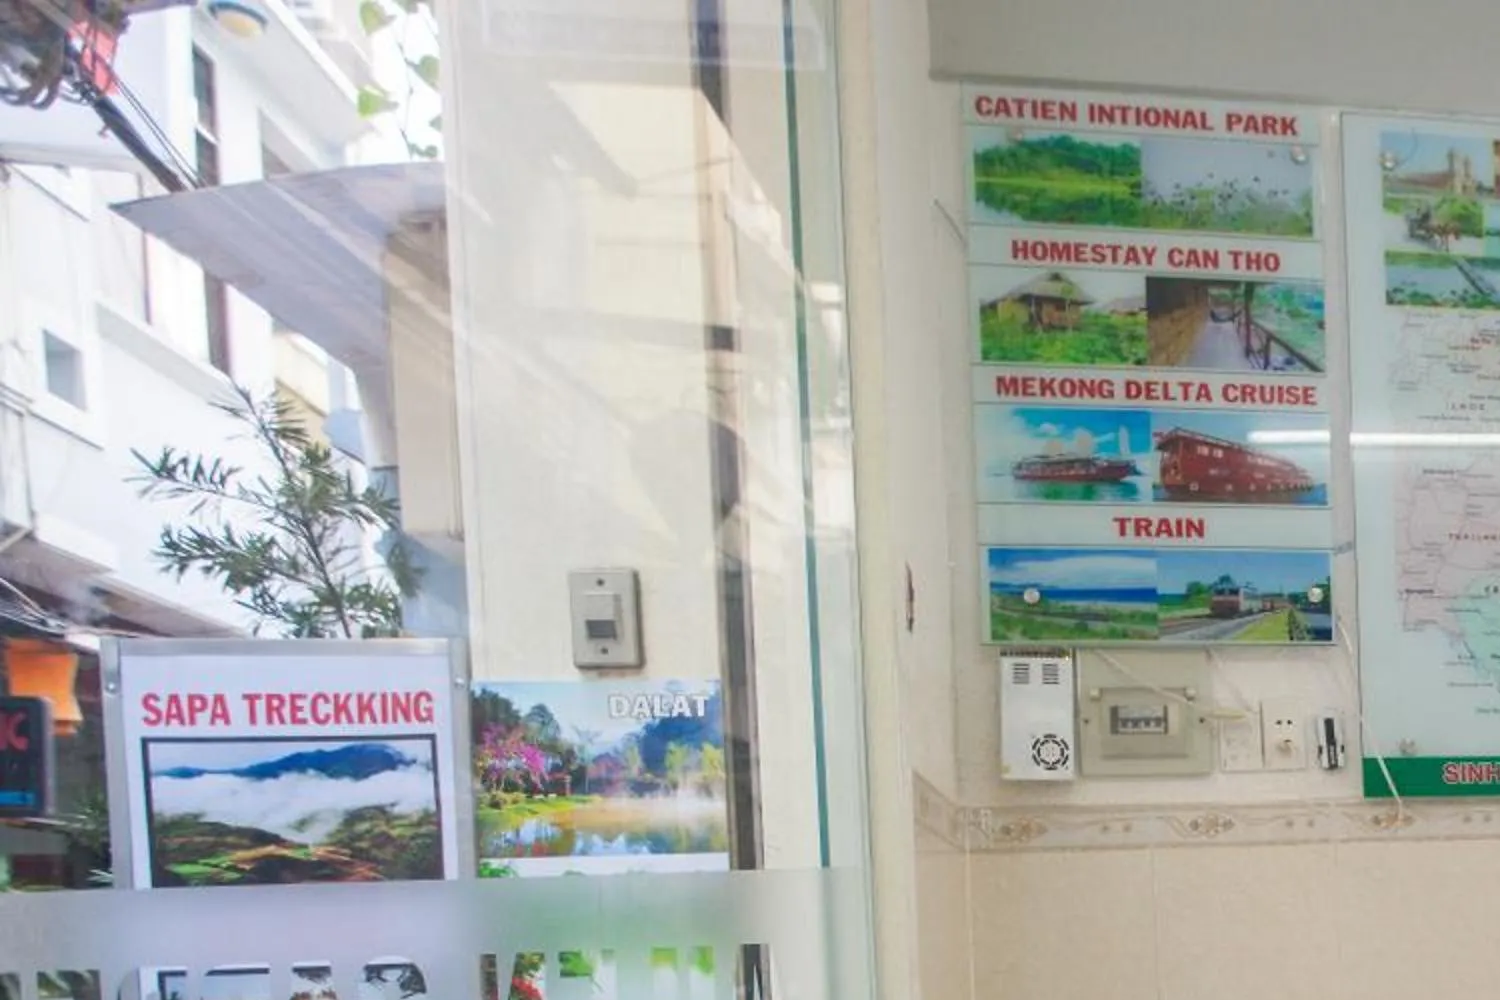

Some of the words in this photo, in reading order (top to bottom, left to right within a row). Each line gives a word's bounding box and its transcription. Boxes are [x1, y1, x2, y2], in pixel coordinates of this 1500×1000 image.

[975, 96, 1078, 122] CATIEN
[1088, 105, 1214, 131] INTIONAL
[1226, 112, 1298, 137] PARK
[1012, 240, 1157, 266] HOMESTAY
[1168, 247, 1220, 270] CAN
[1228, 250, 1281, 272] THO
[996, 375, 1115, 399] MEKONG
[1125, 379, 1213, 402] DELTA
[1222, 382, 1318, 406] CRUISE
[1113, 516, 1206, 539] TRAIN
[141, 692, 232, 727] SAPA
[242, 690, 435, 727] TRECKKING
[607, 694, 709, 719] DALAT
